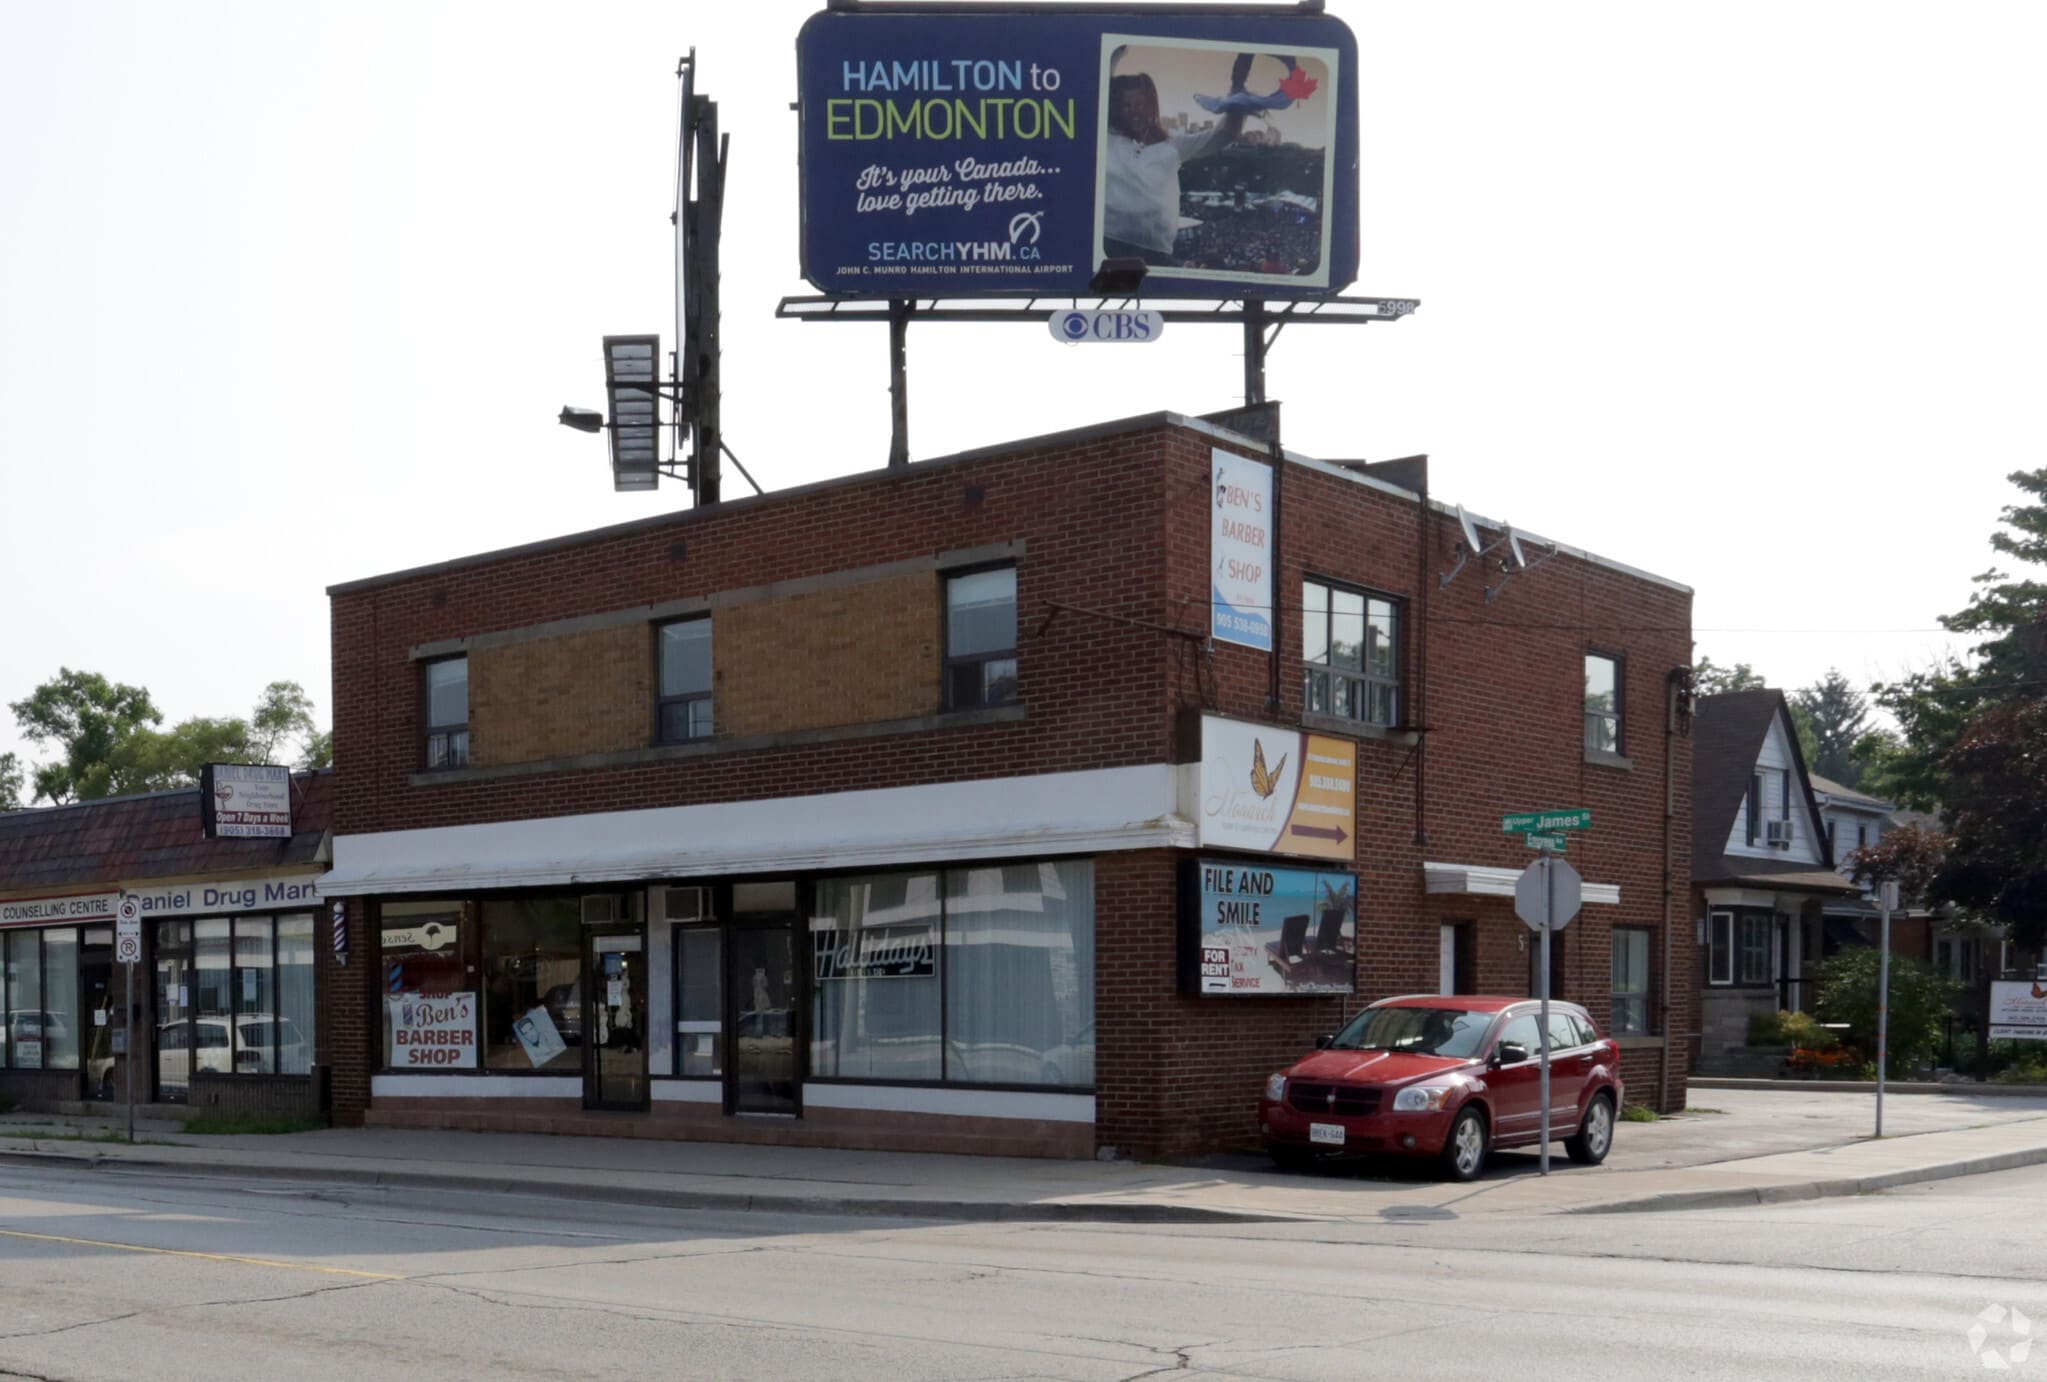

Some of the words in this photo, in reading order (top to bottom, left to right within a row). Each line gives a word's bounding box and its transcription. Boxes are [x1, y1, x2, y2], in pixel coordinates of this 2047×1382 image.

[843, 60, 1022, 91] HAMILTON
[1029, 63, 1061, 91] to
[827, 98, 1075, 140] EDMONTON
[856, 164, 897, 190] It's
[900, 165, 951, 191] your
[856, 191, 903, 212] love
[906, 186, 980, 215] getting
[982, 182, 1043, 203] there.
[836, 266, 861, 275] JOHN
[862, 266, 872, 275] C.
[874, 266, 907, 275] MUNRO
[910, 266, 956, 274] HAMILTON
[960, 265, 1032, 274] INTERNATIONAL
[1034, 264, 1073, 273] AIRPORT
[1378, 301, 1415, 315] 5998
[1092, 313, 1150, 339] CBS
[1226, 485, 1262, 512] BEN'S
[1222, 518, 1265, 548] BARBER
[1228, 559, 1262, 584] SHOP
[216, 812, 236, 824] Open
[236, 812, 242, 822] 7
[243, 812, 261, 825] Days
[269, 813, 289, 823] Week
[1536, 815, 1580, 829] James
[204, 888, 256, 907] Drug
[265, 880, 316, 901] Mart
[1205, 868, 1233, 894] FILE
[1238, 871, 1274, 896] AND
[3, 902, 66, 920] COUNSELLING
[69, 898, 108, 915] CENTRE
[1217, 900, 1260, 926] SMILE
[1204, 949, 1225, 963] FOR
[1201, 963, 1229, 976] RENT
[416, 998, 469, 1028] Ben's
[396, 1030, 474, 1046] BARBER
[408, 1048, 461, 1065] SHOP
